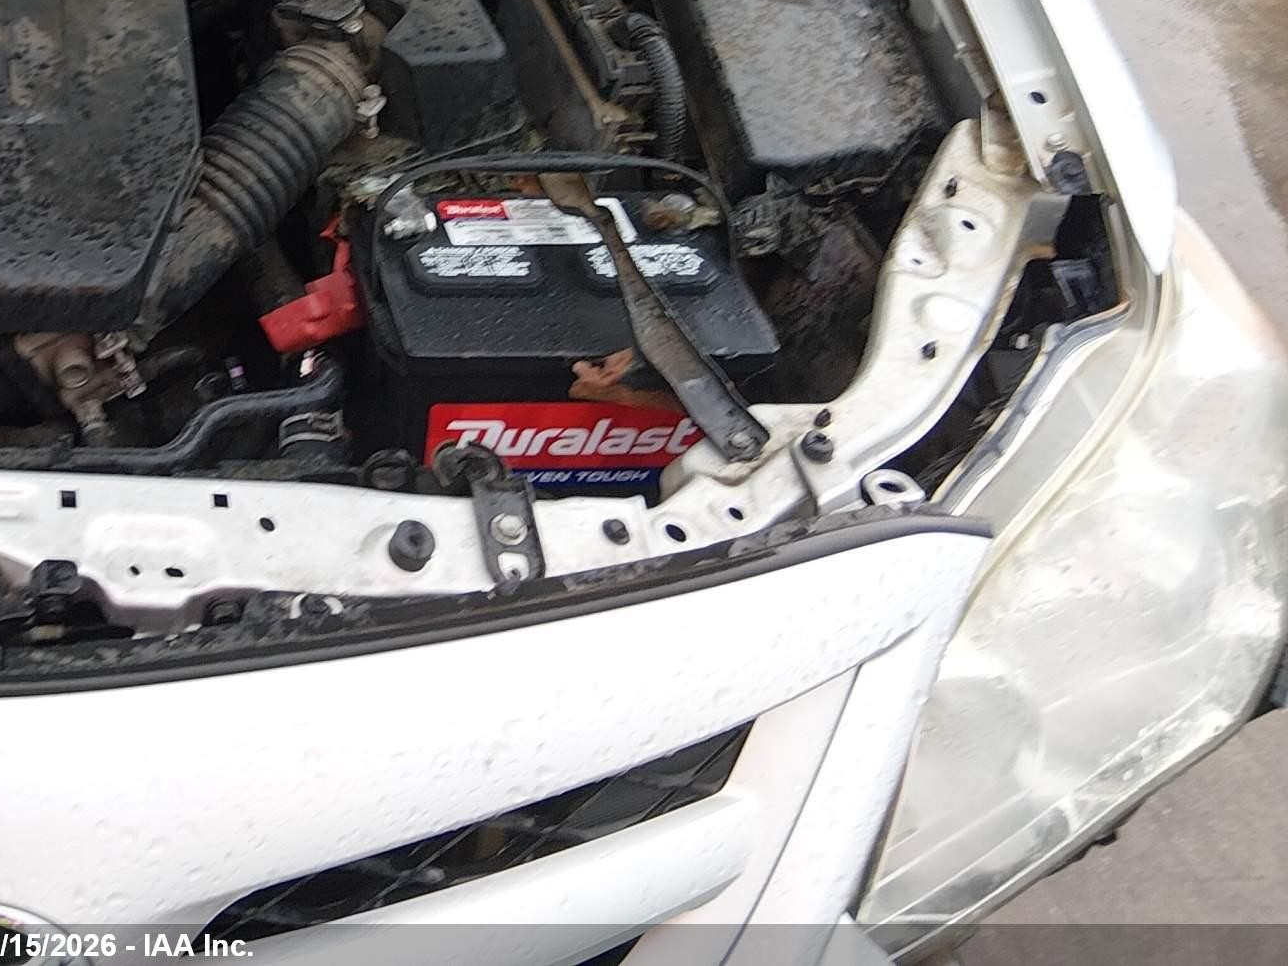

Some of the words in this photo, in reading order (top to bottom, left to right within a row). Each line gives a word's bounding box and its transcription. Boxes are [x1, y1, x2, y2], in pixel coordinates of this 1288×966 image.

[446, 418, 697, 456] Duralast
[526, 470, 572, 483] VEN
[575, 470, 650, 482] TOUGH
